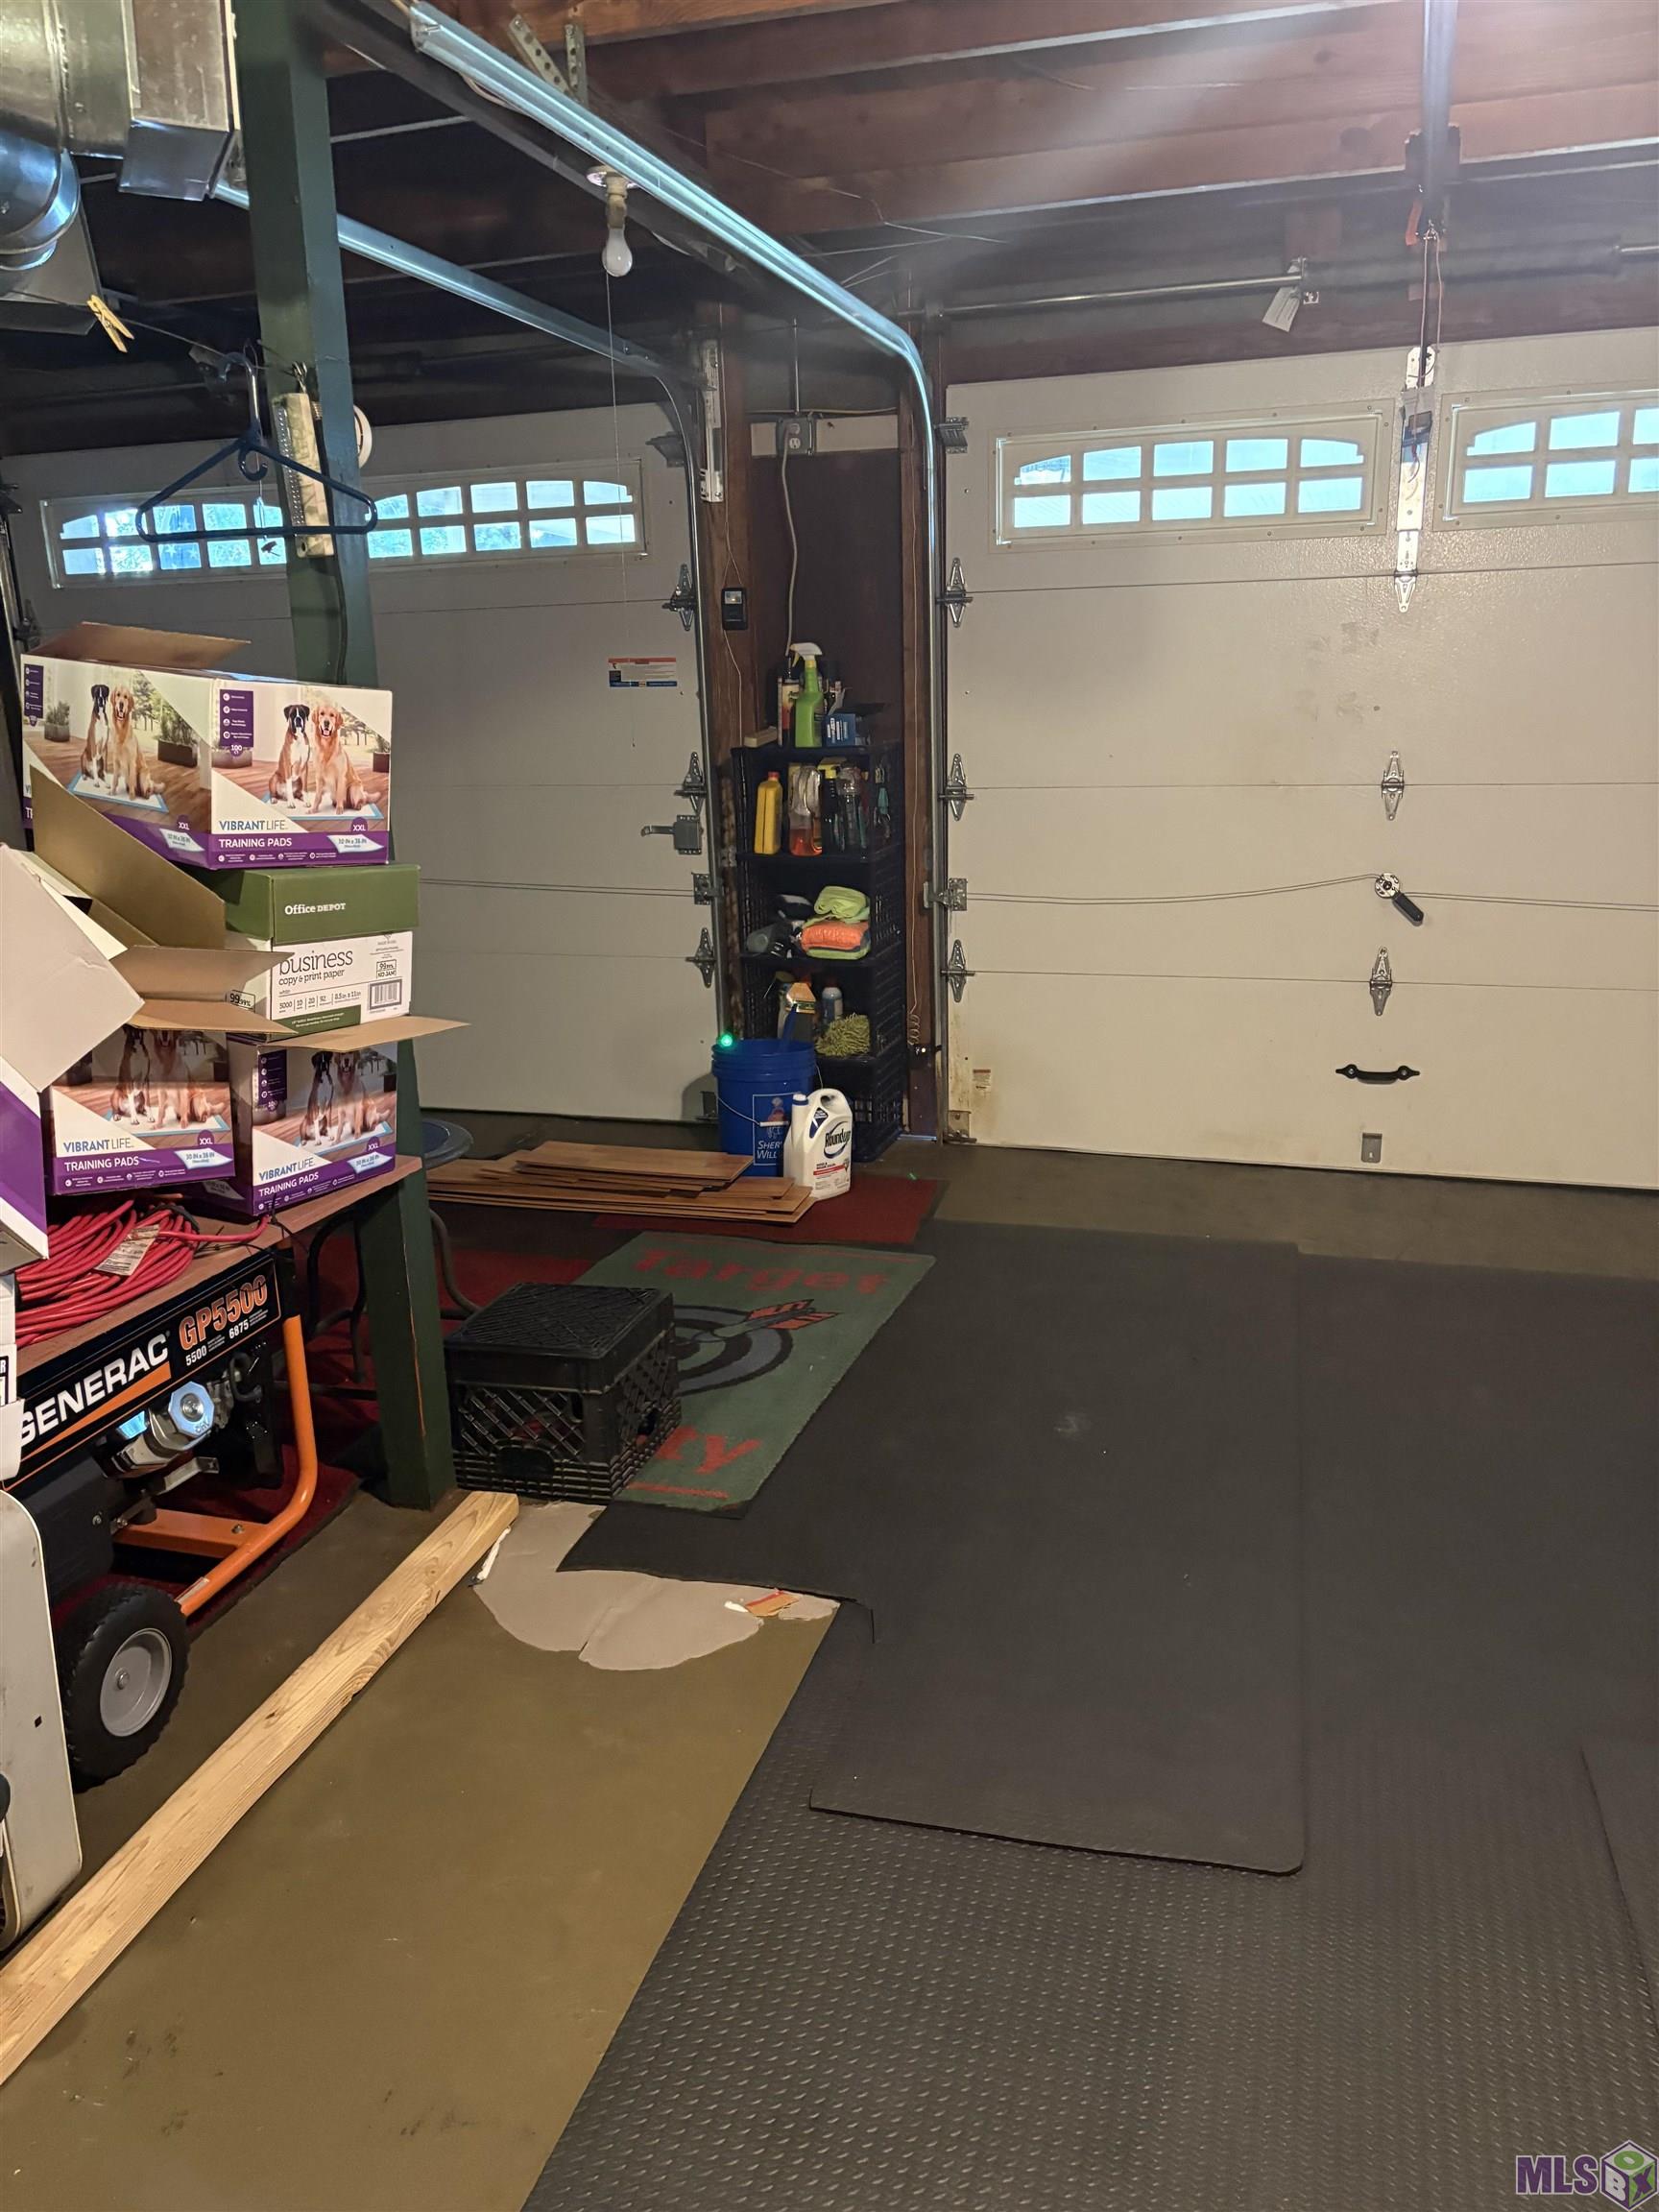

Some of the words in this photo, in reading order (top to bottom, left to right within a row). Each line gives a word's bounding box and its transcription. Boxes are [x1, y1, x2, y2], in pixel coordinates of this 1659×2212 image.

[219, 820, 265, 830] VIBRANT
[266, 820, 286, 830] LIFE
[218, 838, 265, 848] TRAINING
[267, 838, 292, 847] PADS
[284, 904, 316, 915] Office
[317, 902, 346, 912] DEPOT
[279, 950, 353, 975] business
[278, 975, 299, 987] copy
[303, 971, 323, 984] print
[323, 970, 345, 982] paper
[63, 1140, 110, 1153] VIBRANT
[111, 1138, 132, 1149] LIFE
[757, 1141, 783, 1150] SHER
[64, 1158, 112, 1171] TRAINING
[114, 1156, 139, 1167] PADS
[259, 1163, 298, 1181] VIBRANT
[298, 1157, 315, 1170] LIFE
[258, 1179, 297, 1197] TRAINING
[299, 1171, 319, 1185] PADS
[634, 1249, 889, 1294] Target
[179, 1275, 268, 1351] GP5500
[228, 1319, 250, 1339] 6875
[185, 1345, 207, 1366] 5500
[21, 1334, 168, 1447] GENERAC
